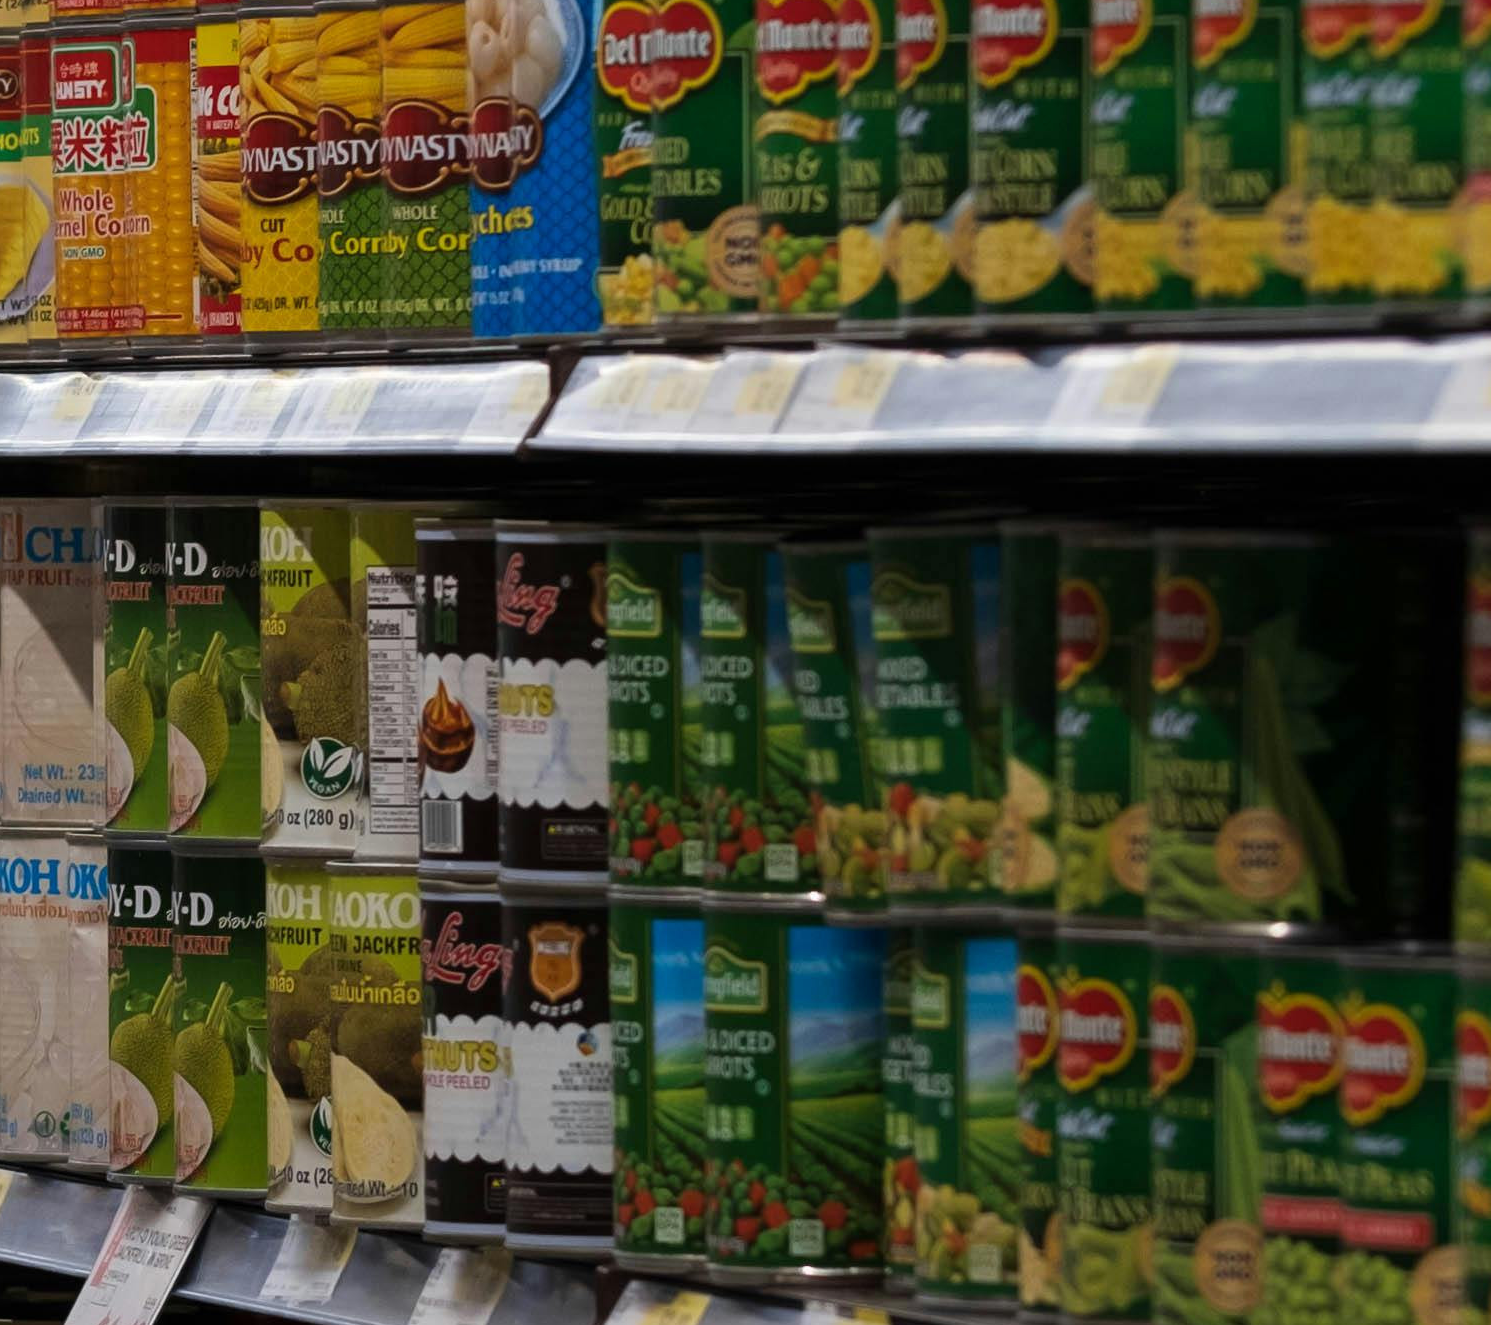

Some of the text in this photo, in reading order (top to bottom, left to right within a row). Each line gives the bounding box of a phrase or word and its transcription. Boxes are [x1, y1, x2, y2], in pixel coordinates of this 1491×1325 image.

[603, 31, 638, 65] Del
[242, 145, 317, 172] DYNAST
[320, 138, 379, 166] NASTY
[59, 189, 113, 213] Whole
[392, 204, 439, 221] WHOLE
[260, 218, 285, 233] CUT
[321, 209, 345, 224] HOLE
[272, 237, 316, 262] Co
[417, 226, 469, 252] Cor
[27, 569, 71, 587] FRUIT
[307, 776, 341, 794] VEGAN
[287, 807, 355, 831] oz (280 g)
[353, 935, 419, 957] JACKFR
[402, 1180, 418, 1197] 10
